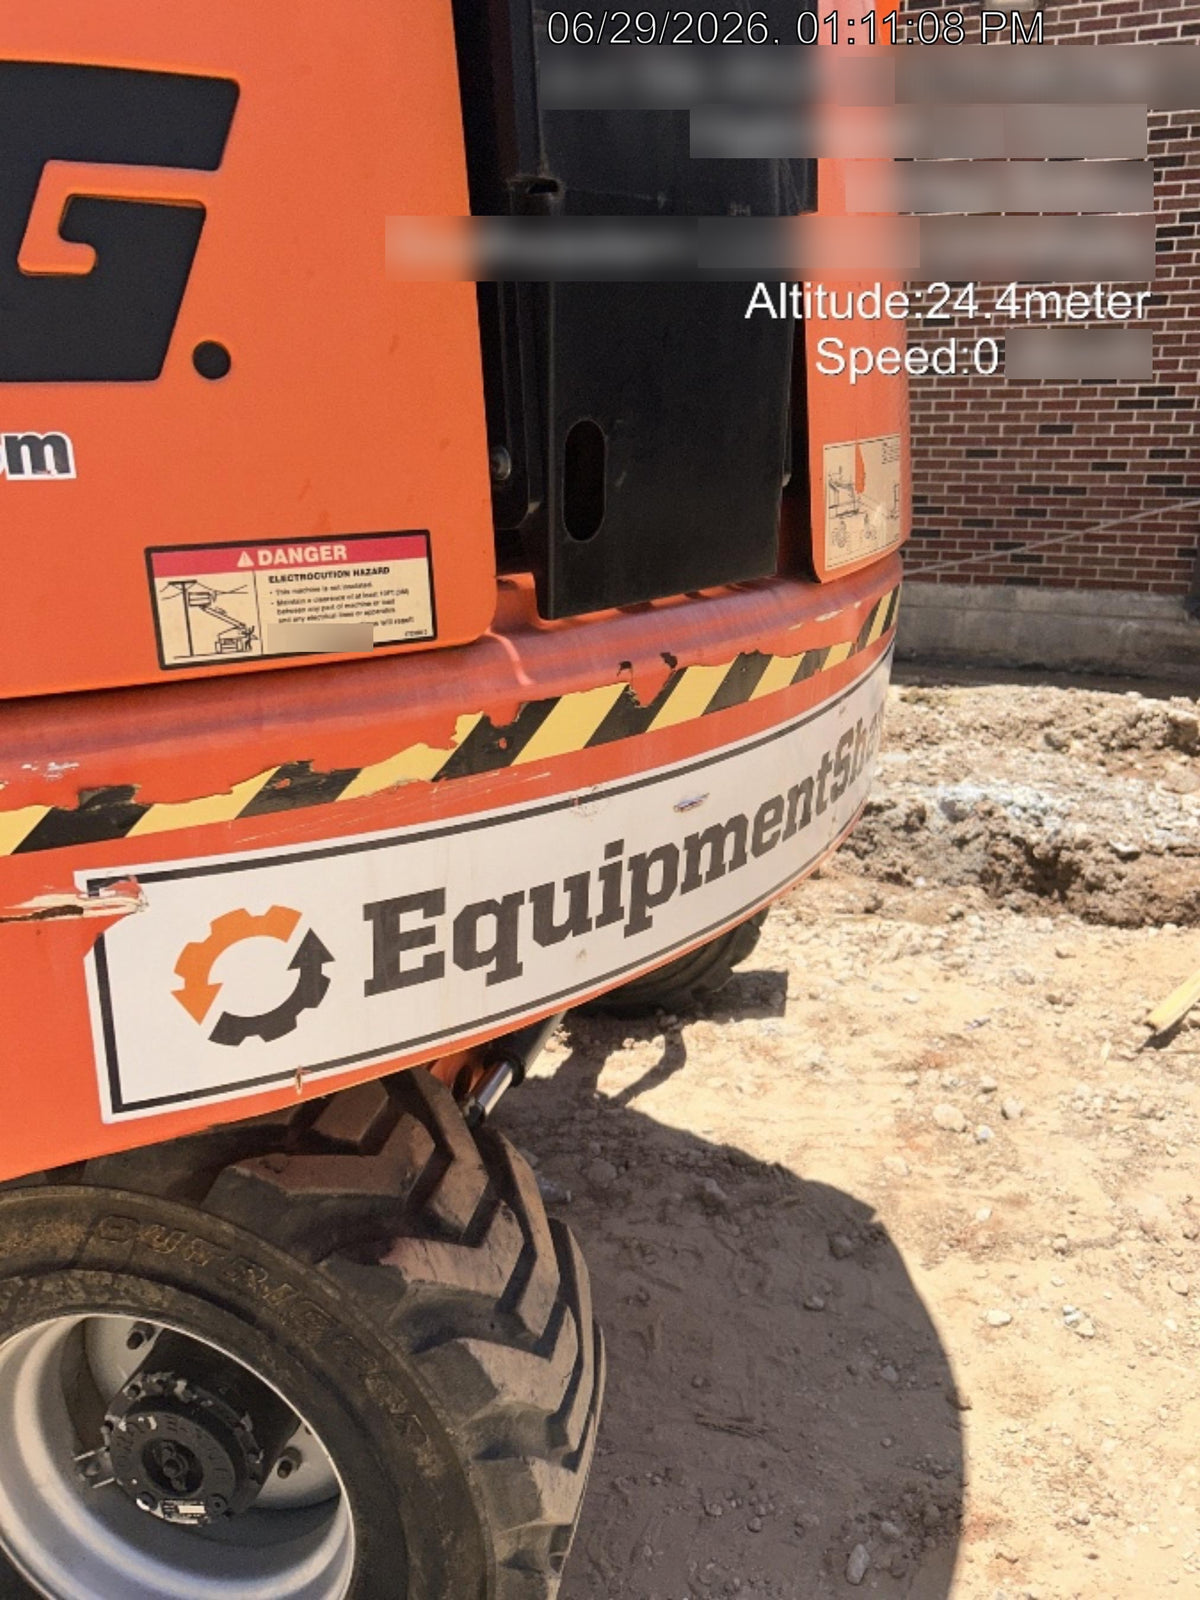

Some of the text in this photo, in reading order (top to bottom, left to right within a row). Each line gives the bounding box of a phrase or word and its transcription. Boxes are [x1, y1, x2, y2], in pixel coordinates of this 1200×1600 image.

[0, 430, 77, 481] m
[257, 544, 348, 567] DANGER
[268, 566, 391, 584] ELECTROCUTION HAZARD
